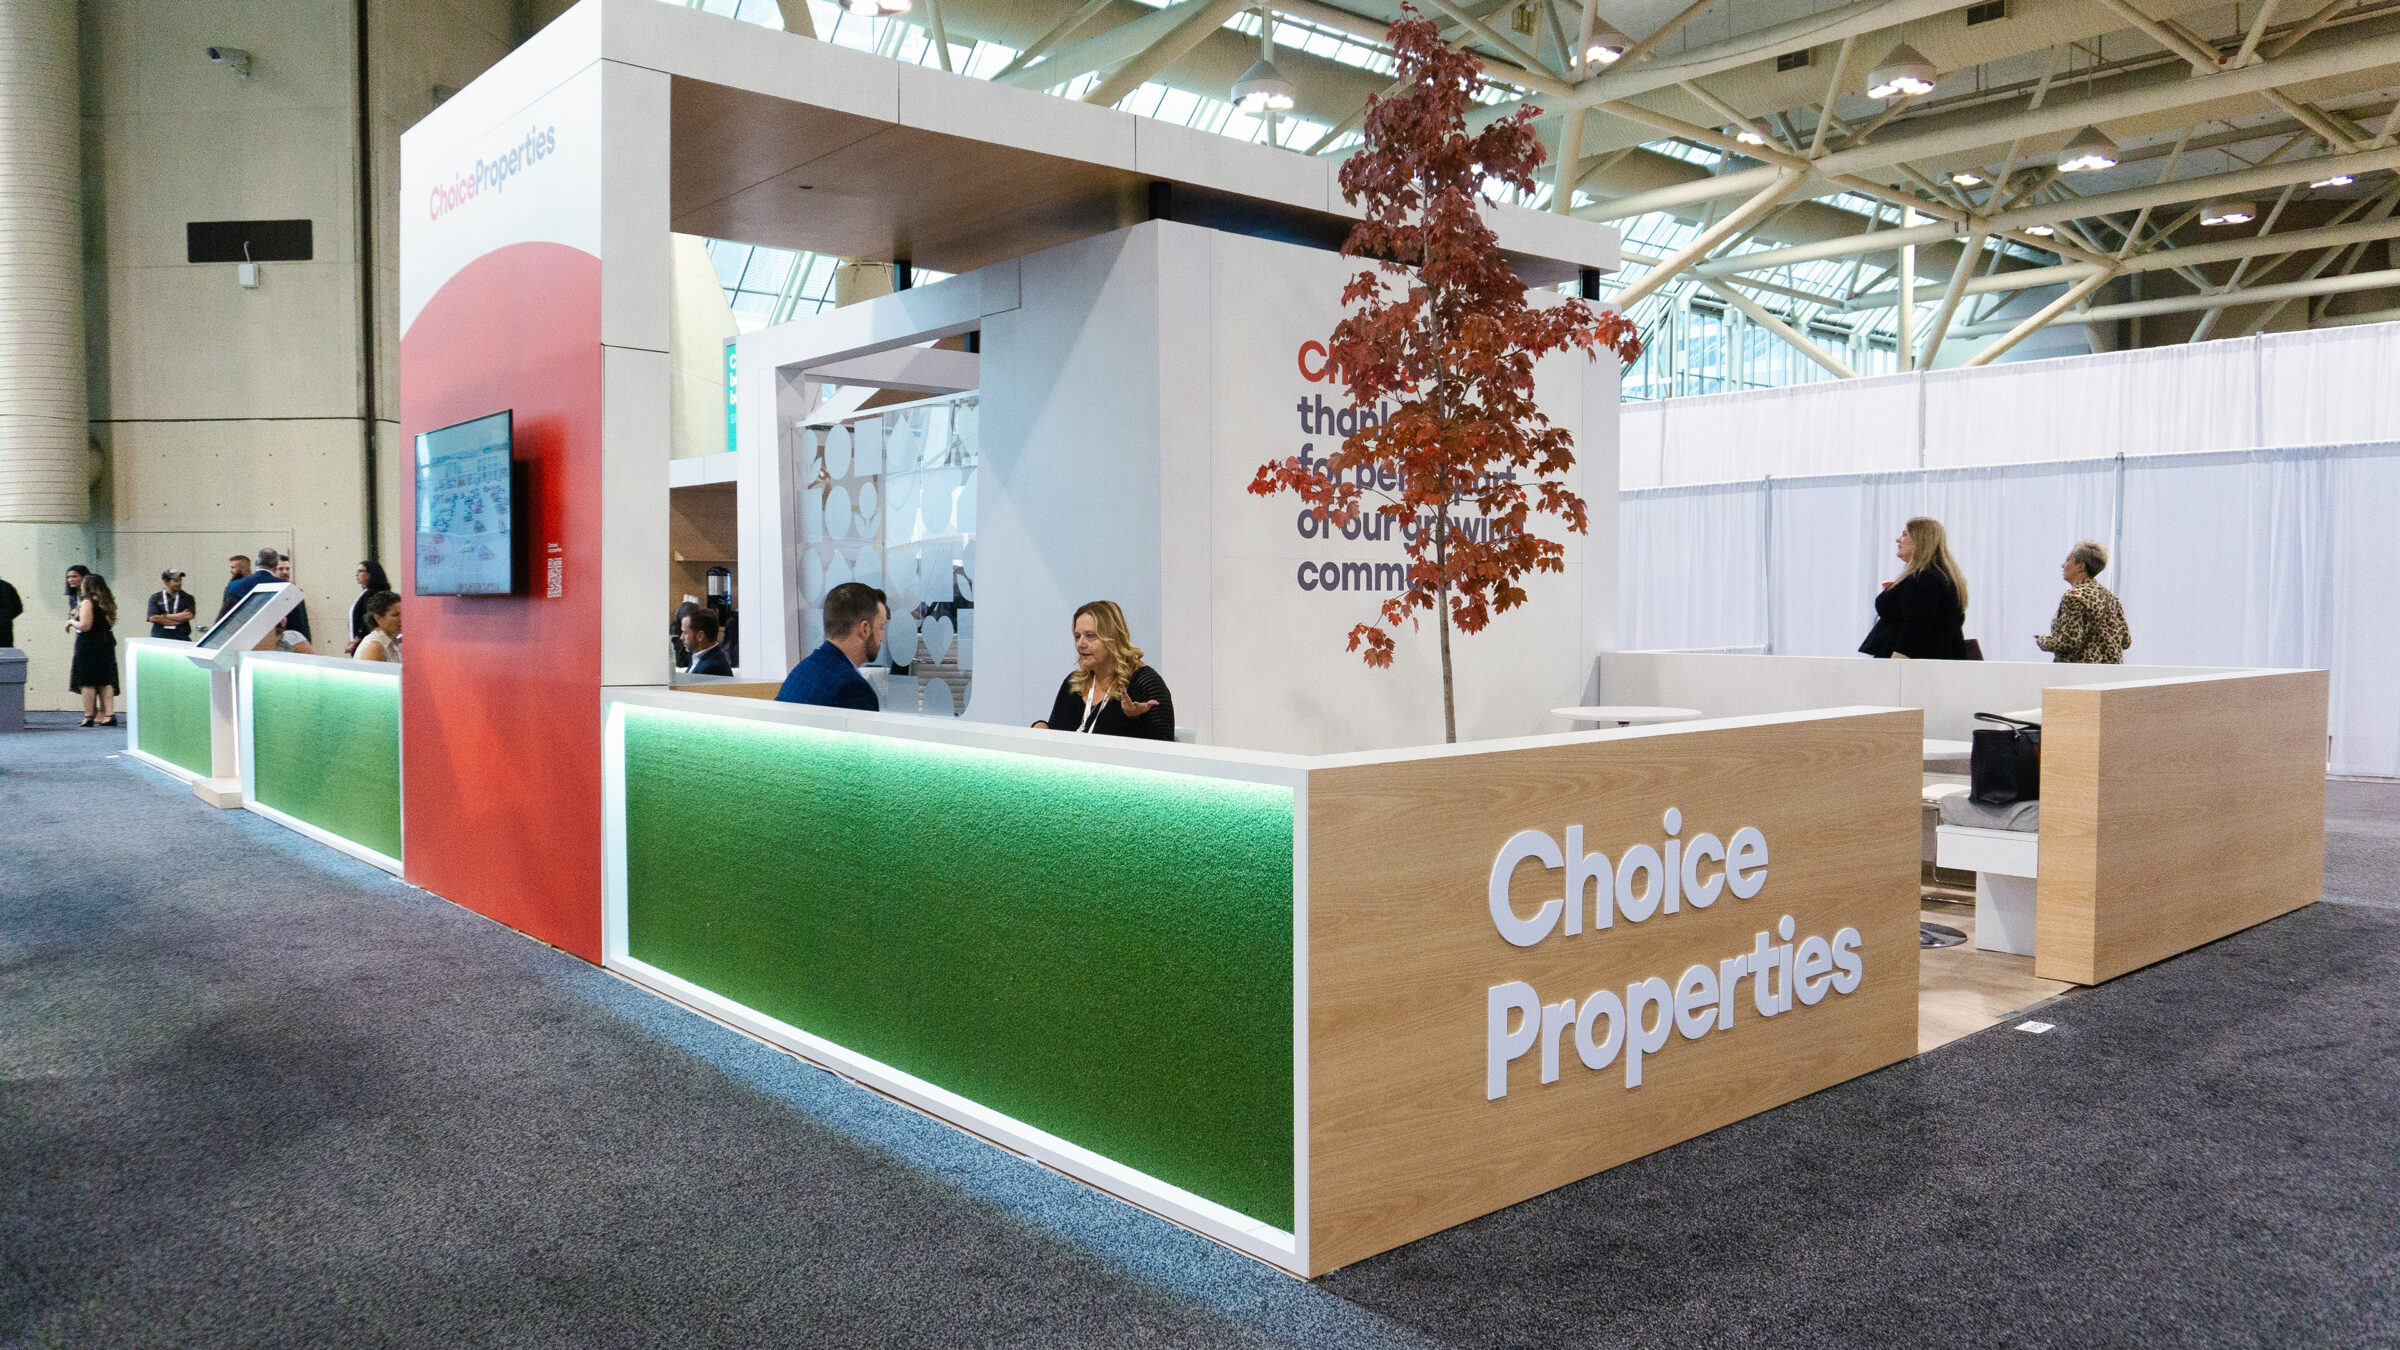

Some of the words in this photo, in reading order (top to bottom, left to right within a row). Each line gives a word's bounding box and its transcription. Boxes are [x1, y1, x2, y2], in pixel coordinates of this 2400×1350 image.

[429, 124, 556, 221] ChoiceProperties
[1341, 512, 1397, 541] our
[1489, 807, 1769, 947] Choice
[1487, 915, 1863, 1100] Properties
